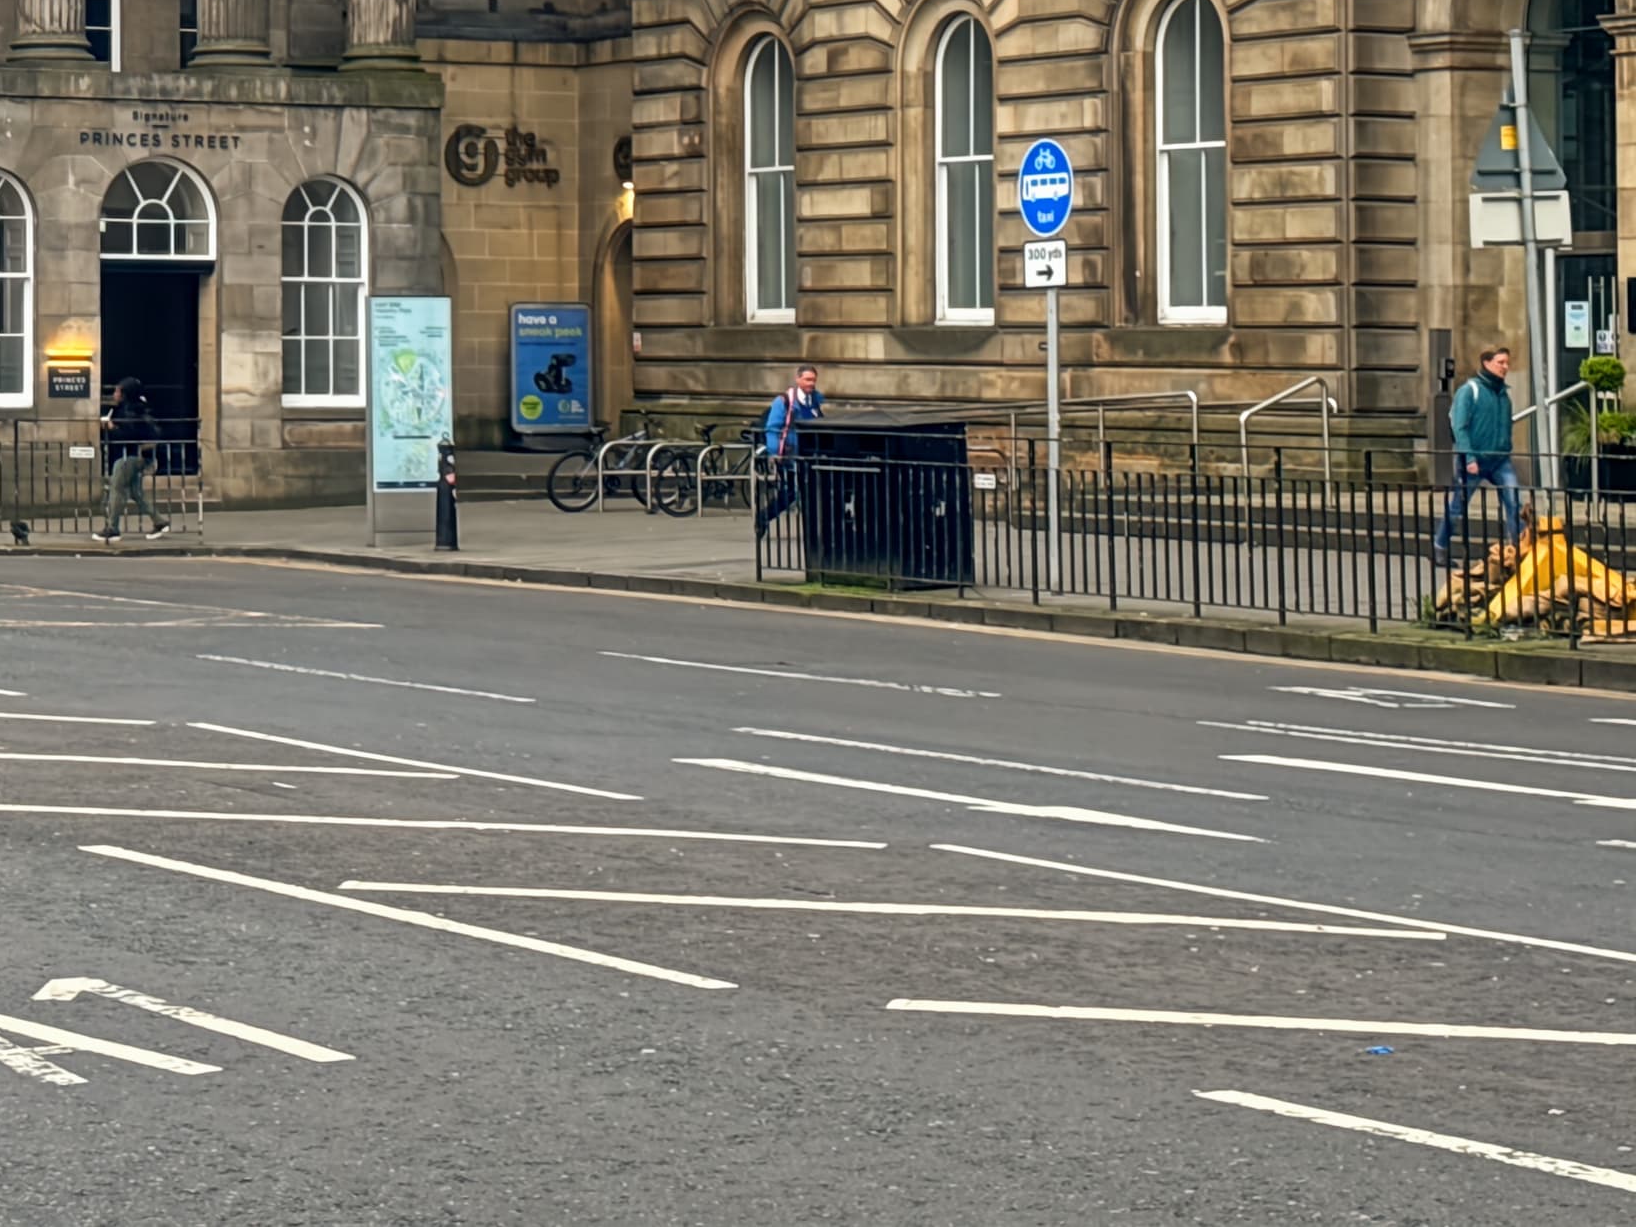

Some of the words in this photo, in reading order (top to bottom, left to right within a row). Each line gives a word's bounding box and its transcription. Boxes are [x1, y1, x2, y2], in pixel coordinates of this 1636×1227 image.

[132, 110, 189, 122] Signature
[79, 132, 162, 147] PRINCES
[171, 134, 241, 149] STREET
[504, 125, 536, 147] the
[504, 147, 548, 166] gym
[504, 168, 560, 189] group
[1037, 210, 1055, 223] taxi
[1028, 248, 1046, 260] 300
[1048, 247, 1062, 261] yds
[518, 313, 546, 324] have
[548, 315, 557, 325] a
